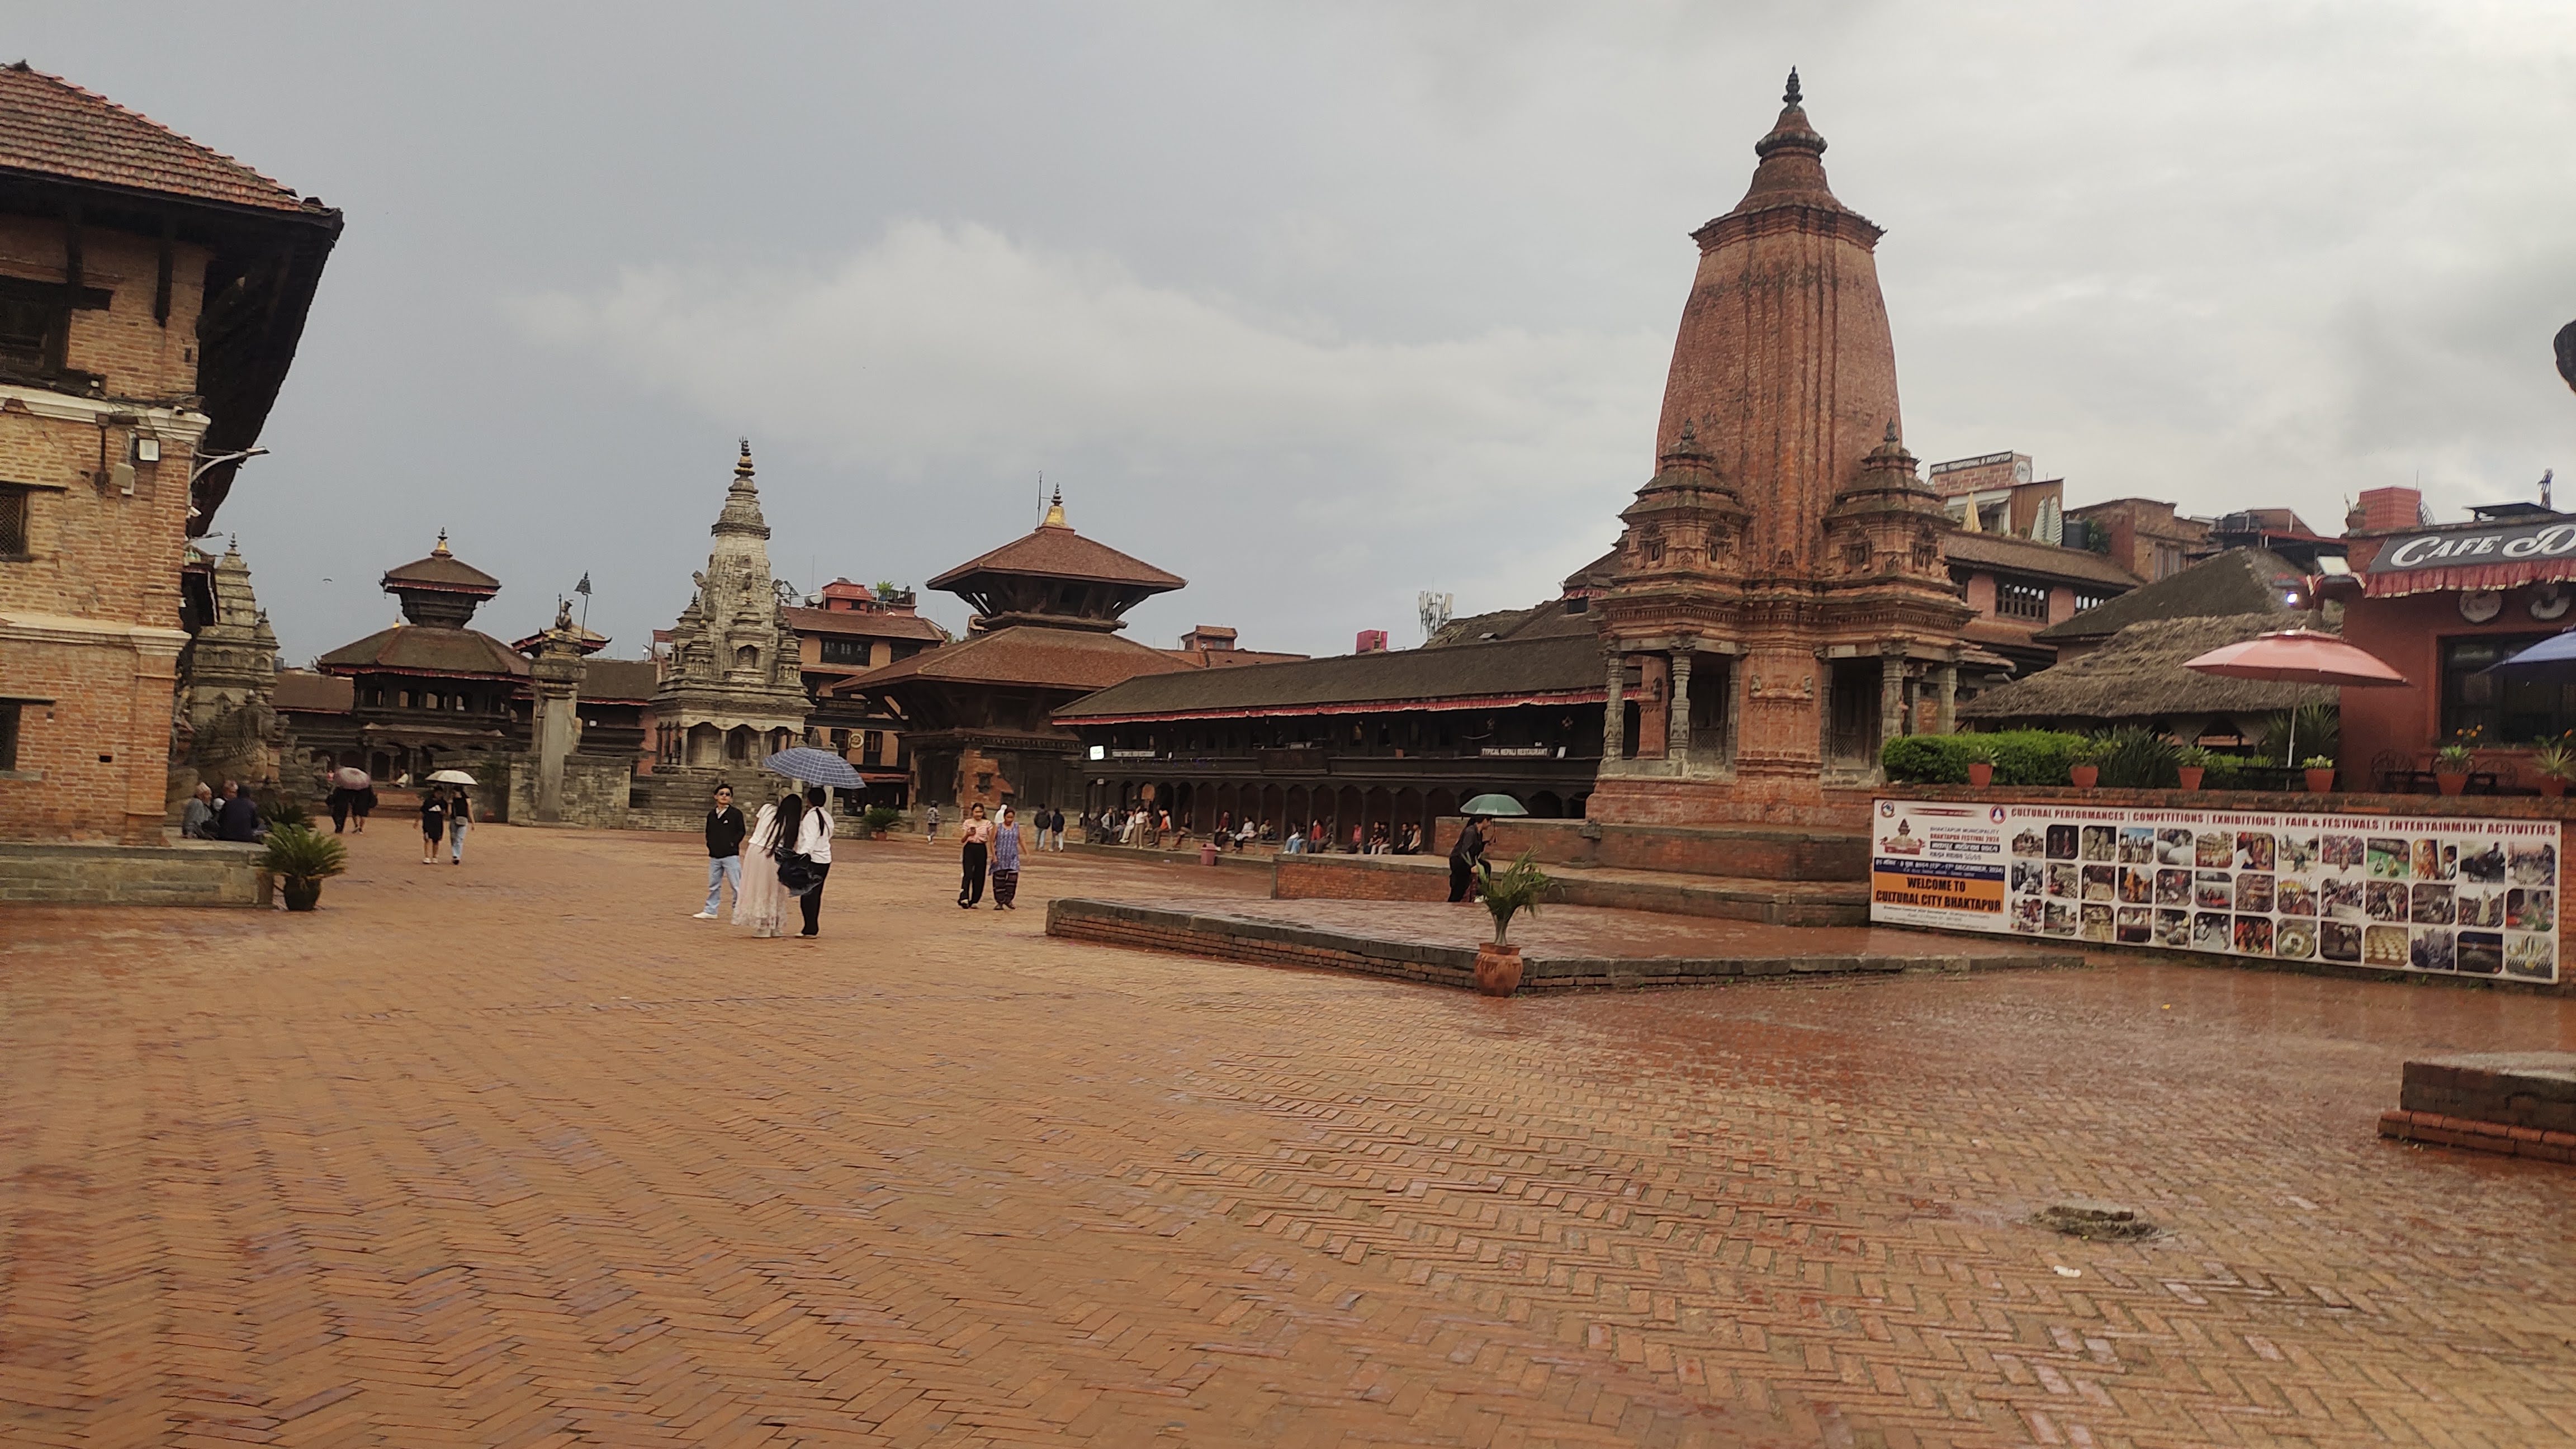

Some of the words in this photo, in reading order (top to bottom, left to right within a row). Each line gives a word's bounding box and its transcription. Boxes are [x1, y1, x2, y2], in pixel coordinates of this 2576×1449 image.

[2390, 535, 2503, 567] CAFE
[1482, 747, 1499, 756] TYPICAL
[1500, 747, 1517, 756] NEPALI
[1517, 747, 1548, 756] RESTAURANT
[2011, 808, 2052, 818] CULTURAL
[2055, 809, 2124, 821] PERFORMANCES
[2133, 812, 2203, 823] COMPETITIONS
[2212, 815, 2276, 826] EXHIBITIONS
[2286, 816, 2309, 827] FAIR
[2312, 818, 2319, 827] &
[2323, 817, 2379, 830] FESTIVALS
[2389, 820, 2483, 833] ENTERTAINMENT
[2487, 823, 2556, 836] ACTIVITIES
[1907, 877, 1951, 891] WELCOME
[1954, 880, 1966, 892] TO
[1876, 890, 1919, 905] CULTURAL
[1921, 894, 1942, 907] CITY
[1944, 897, 2001, 912] BHAKTAPUR
